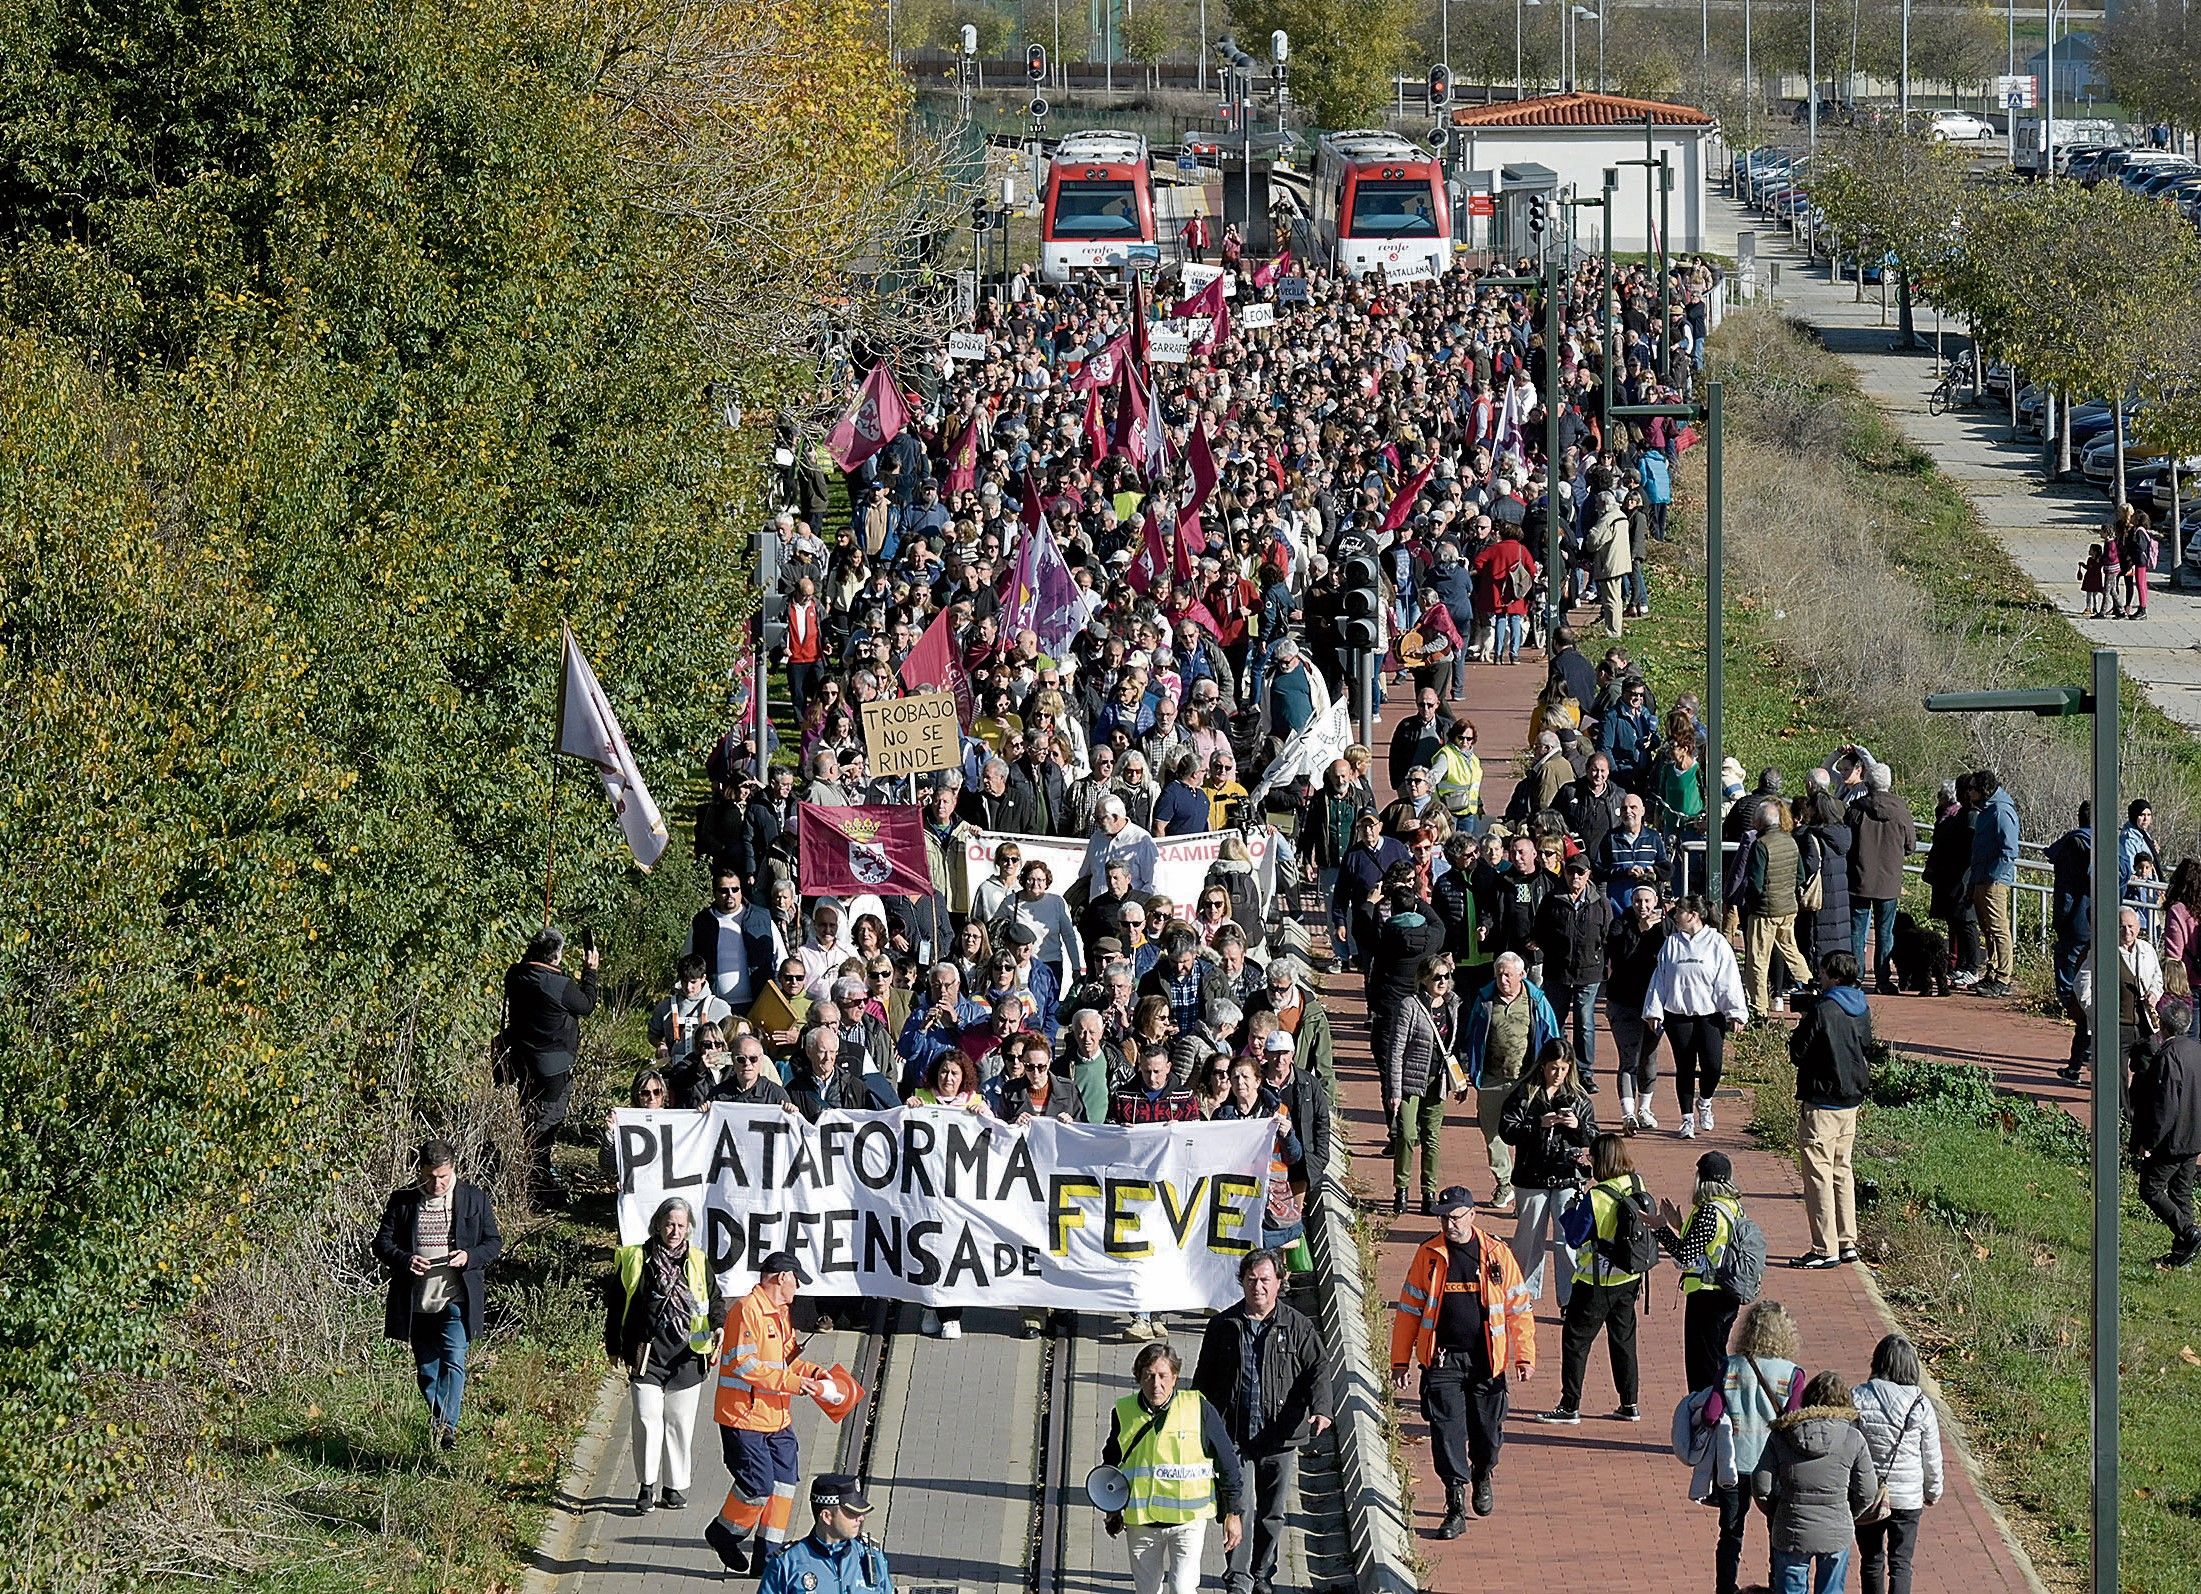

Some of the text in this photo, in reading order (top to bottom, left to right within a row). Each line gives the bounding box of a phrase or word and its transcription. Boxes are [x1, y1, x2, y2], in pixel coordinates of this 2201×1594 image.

[1082, 245, 1114, 256] renfe
[1378, 243, 1409, 253] renfe
[1244, 306, 1272, 323] LEÓN
[863, 700, 954, 730] TROBAJO
[883, 724, 943, 748] NO SE
[879, 745, 944, 773] RINDE
[619, 1118, 1045, 1202] PLATAFORMA
[706, 1173, 1262, 1288] DEFENSA DE FEVE
